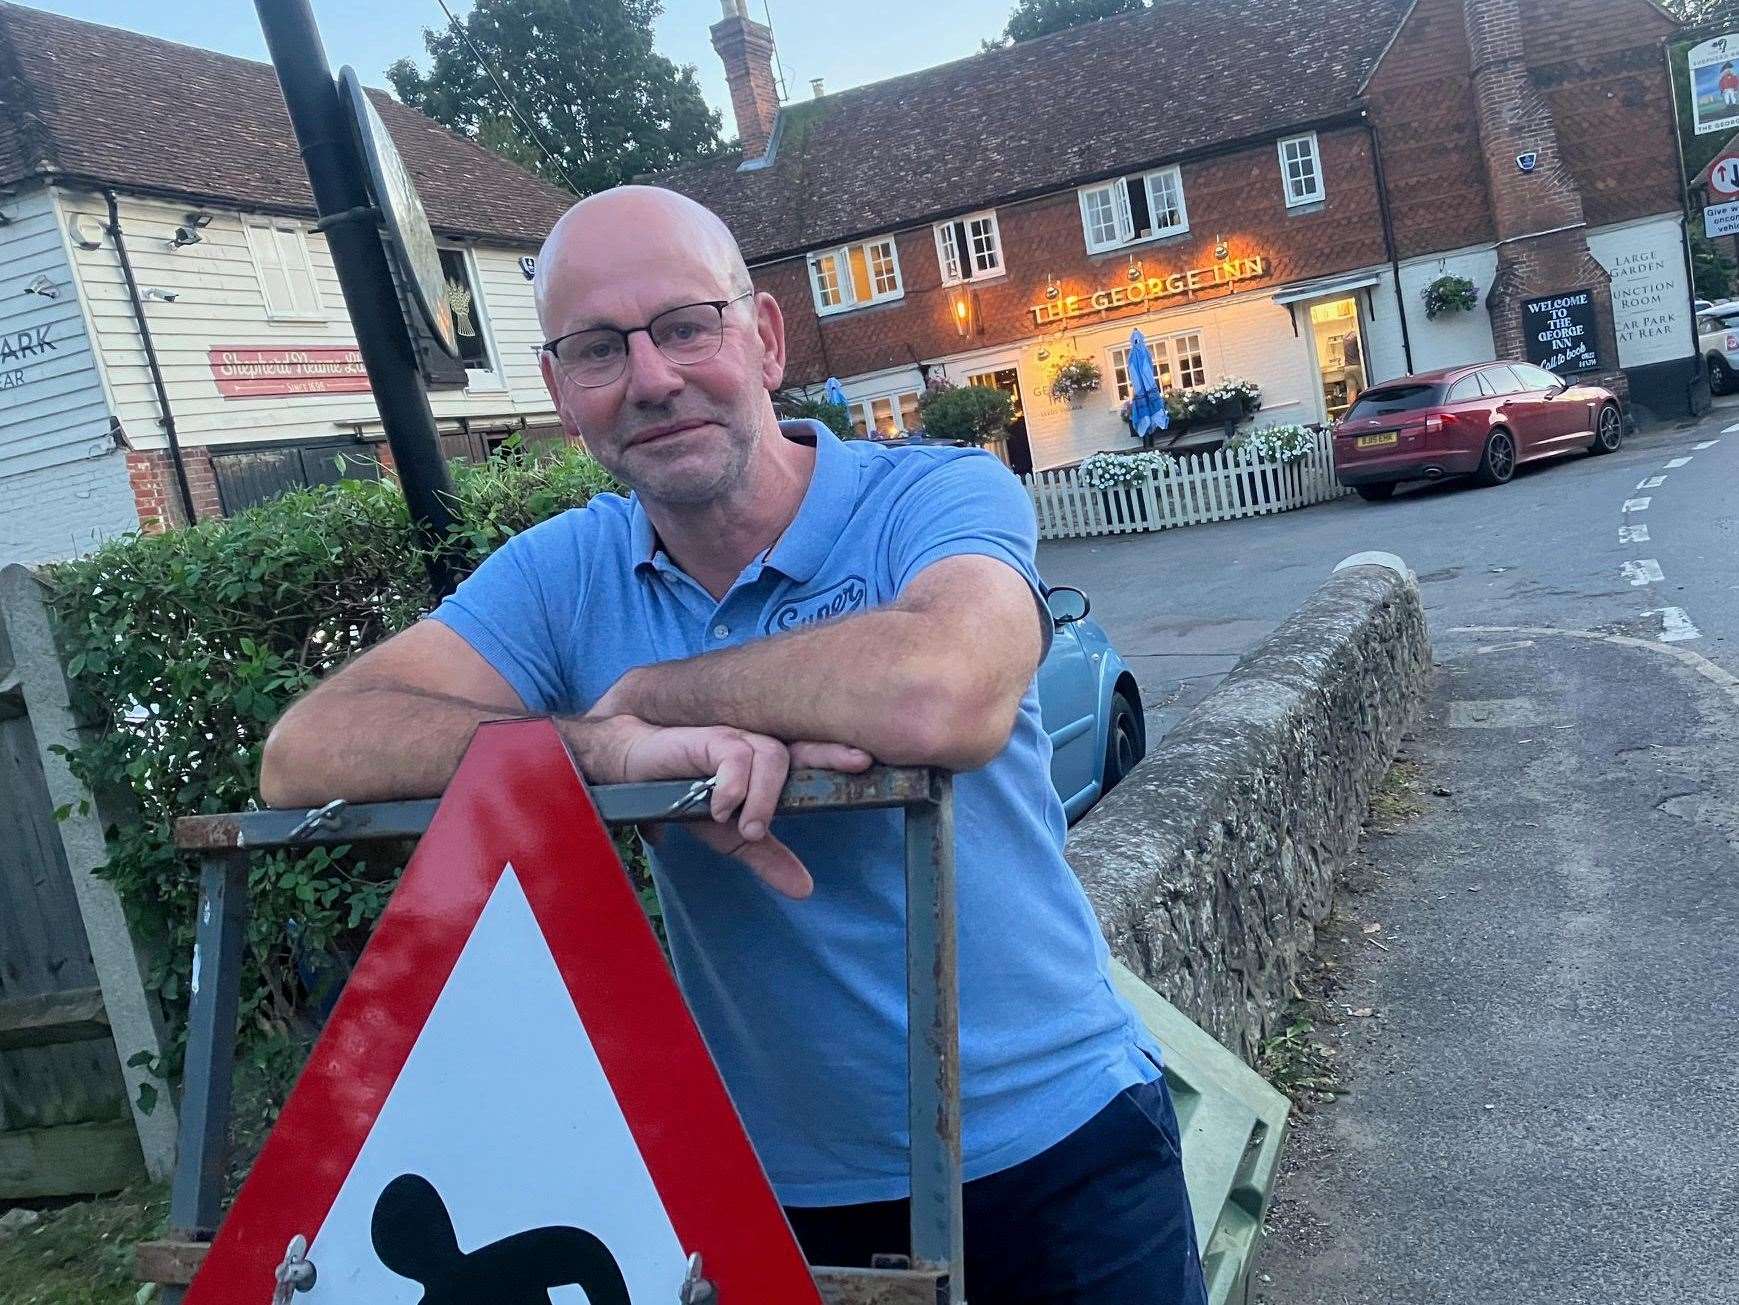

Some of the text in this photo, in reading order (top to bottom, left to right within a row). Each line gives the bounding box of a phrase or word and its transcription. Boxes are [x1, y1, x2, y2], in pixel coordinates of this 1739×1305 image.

[1698, 124, 1713, 132] THE
[1707, 207, 1728, 217] Give
[1615, 250, 1656, 267] LARGE
[1609, 261, 1665, 278] GARDEN
[1031, 255, 1263, 325] THE GEORGE INN
[1613, 281, 1675, 300] UNCTION
[1528, 294, 1588, 314] WELCOME
[1621, 295, 1662, 309] ROOM
[1550, 308, 1567, 320] TO
[1643, 313, 1676, 327] PARK
[1547, 317, 1572, 330] THE
[1538, 325, 1584, 342] GEORGE
[1619, 325, 1672, 342] AT REAR
[1552, 337, 1572, 350] INN
[221, 351, 292, 379] Shepherd
[291, 351, 342, 375] Neame
[1540, 355, 1558, 370] Call
[1557, 353, 1565, 365] to
[0, 369, 25, 390] AR
